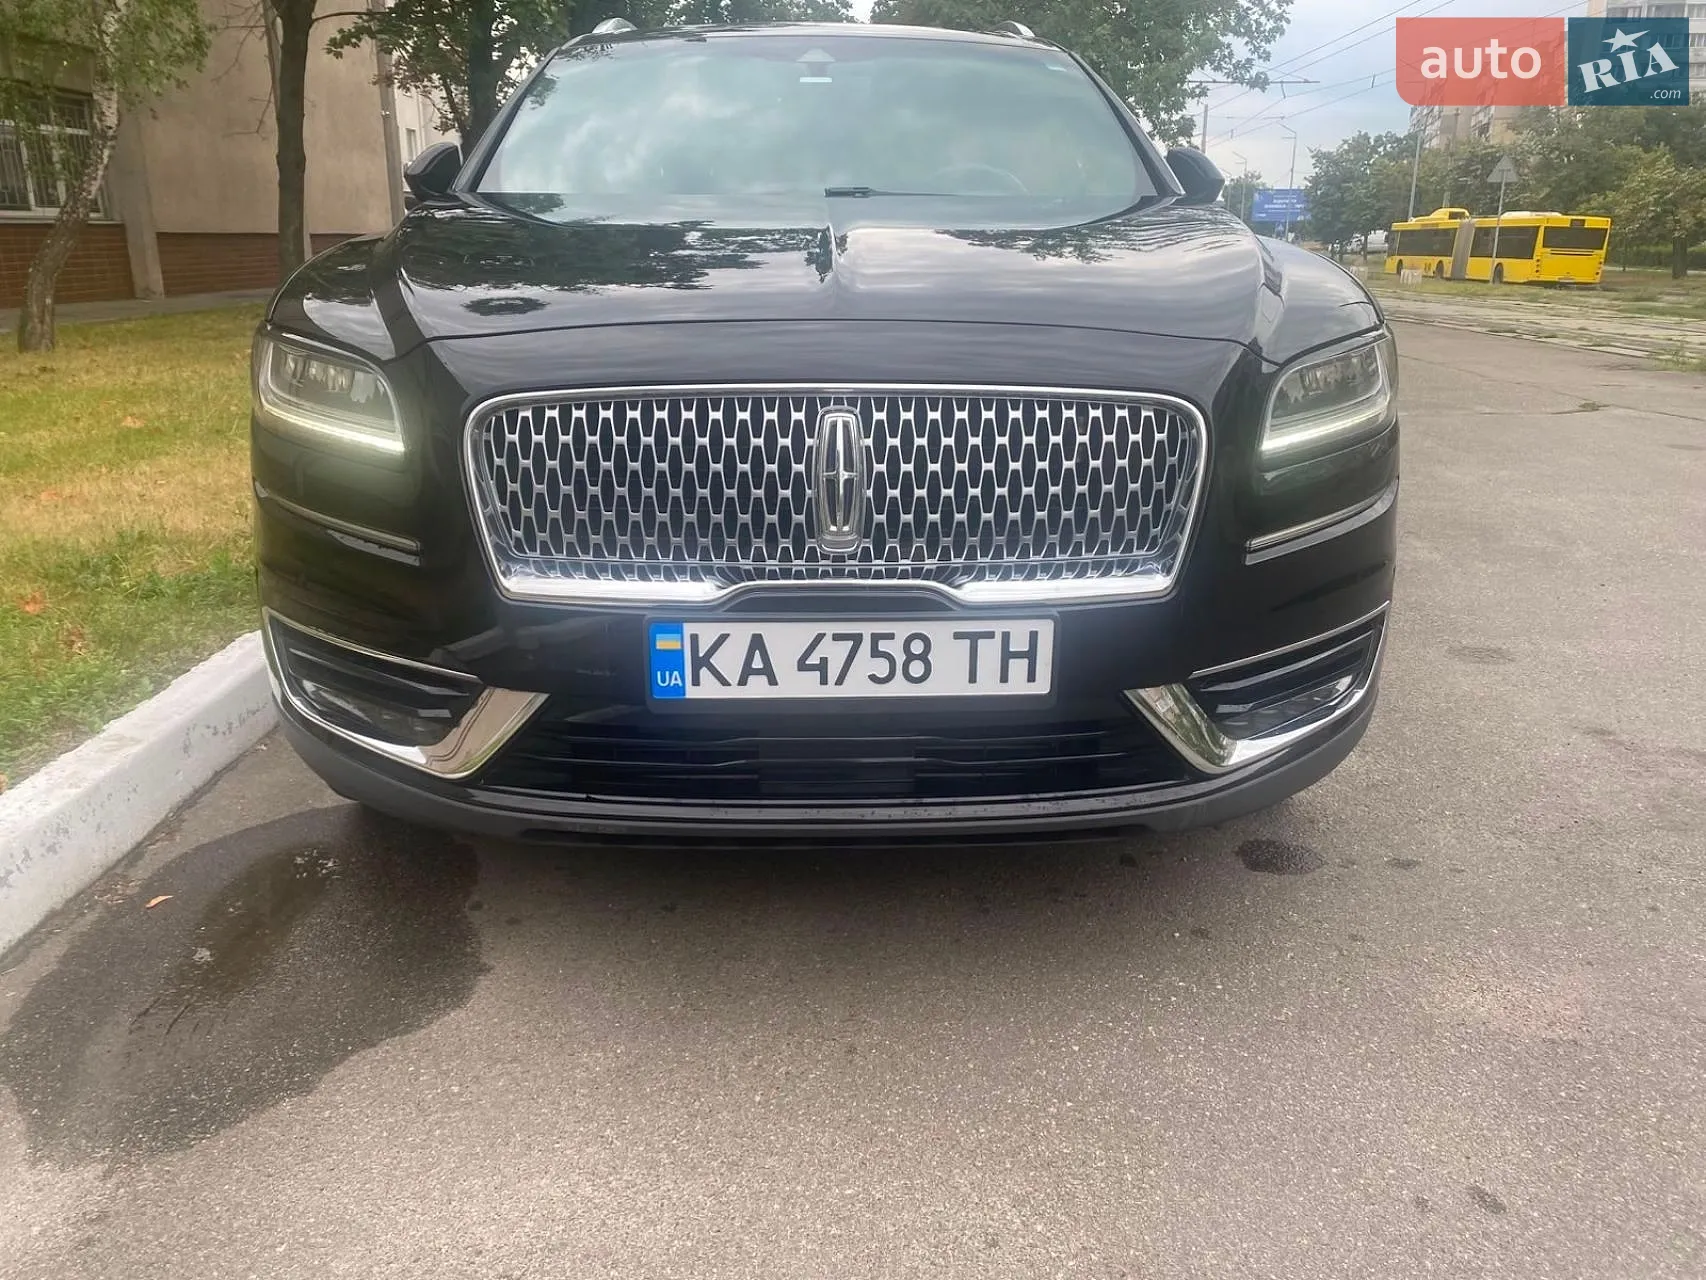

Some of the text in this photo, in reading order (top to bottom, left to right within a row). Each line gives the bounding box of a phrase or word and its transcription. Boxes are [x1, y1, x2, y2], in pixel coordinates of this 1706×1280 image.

[689, 630, 1039, 687] KA 4758 TH
[656, 670, 683, 687] UA
